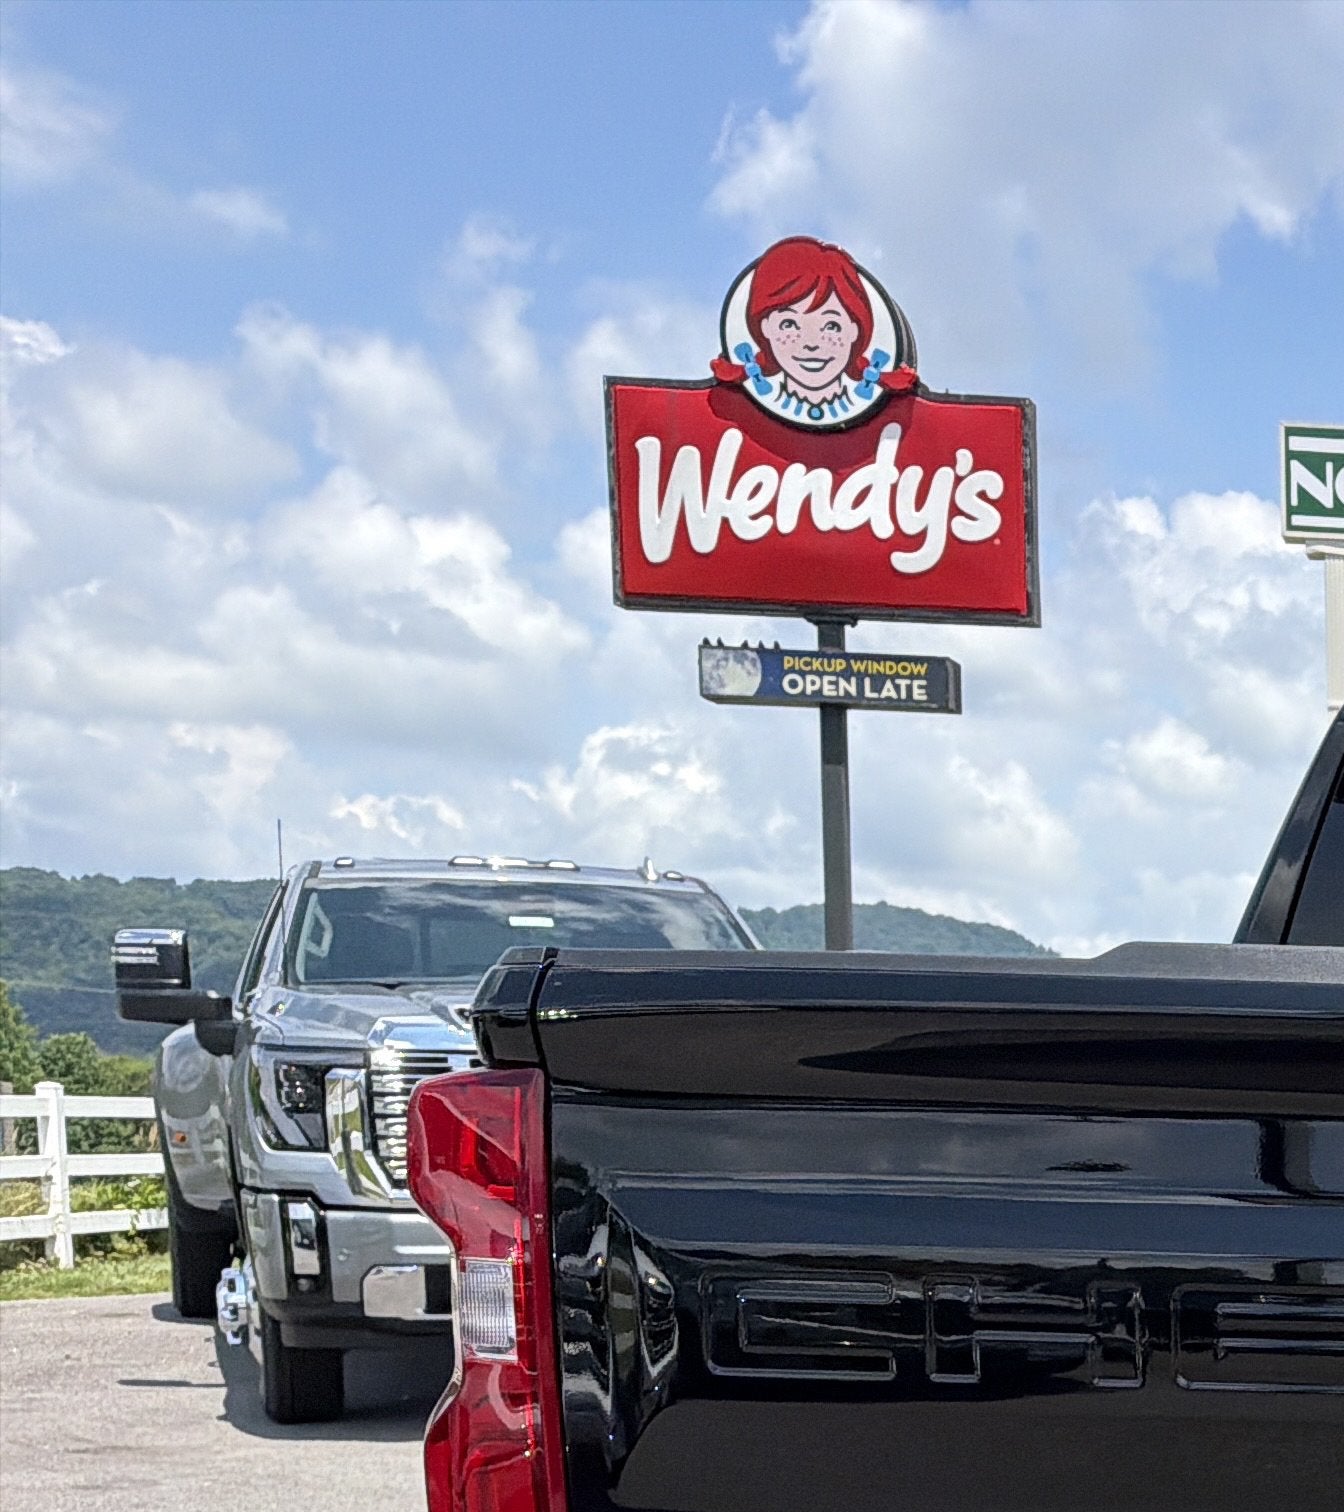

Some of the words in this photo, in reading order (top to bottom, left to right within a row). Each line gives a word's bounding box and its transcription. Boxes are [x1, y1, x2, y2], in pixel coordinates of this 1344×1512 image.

[635, 422, 1004, 575] Wendy's
[783, 656, 846, 672] PICKUP
[850, 659, 928, 676] WINDOW
[782, 673, 857, 697] OPEN
[864, 677, 928, 700] LATE
